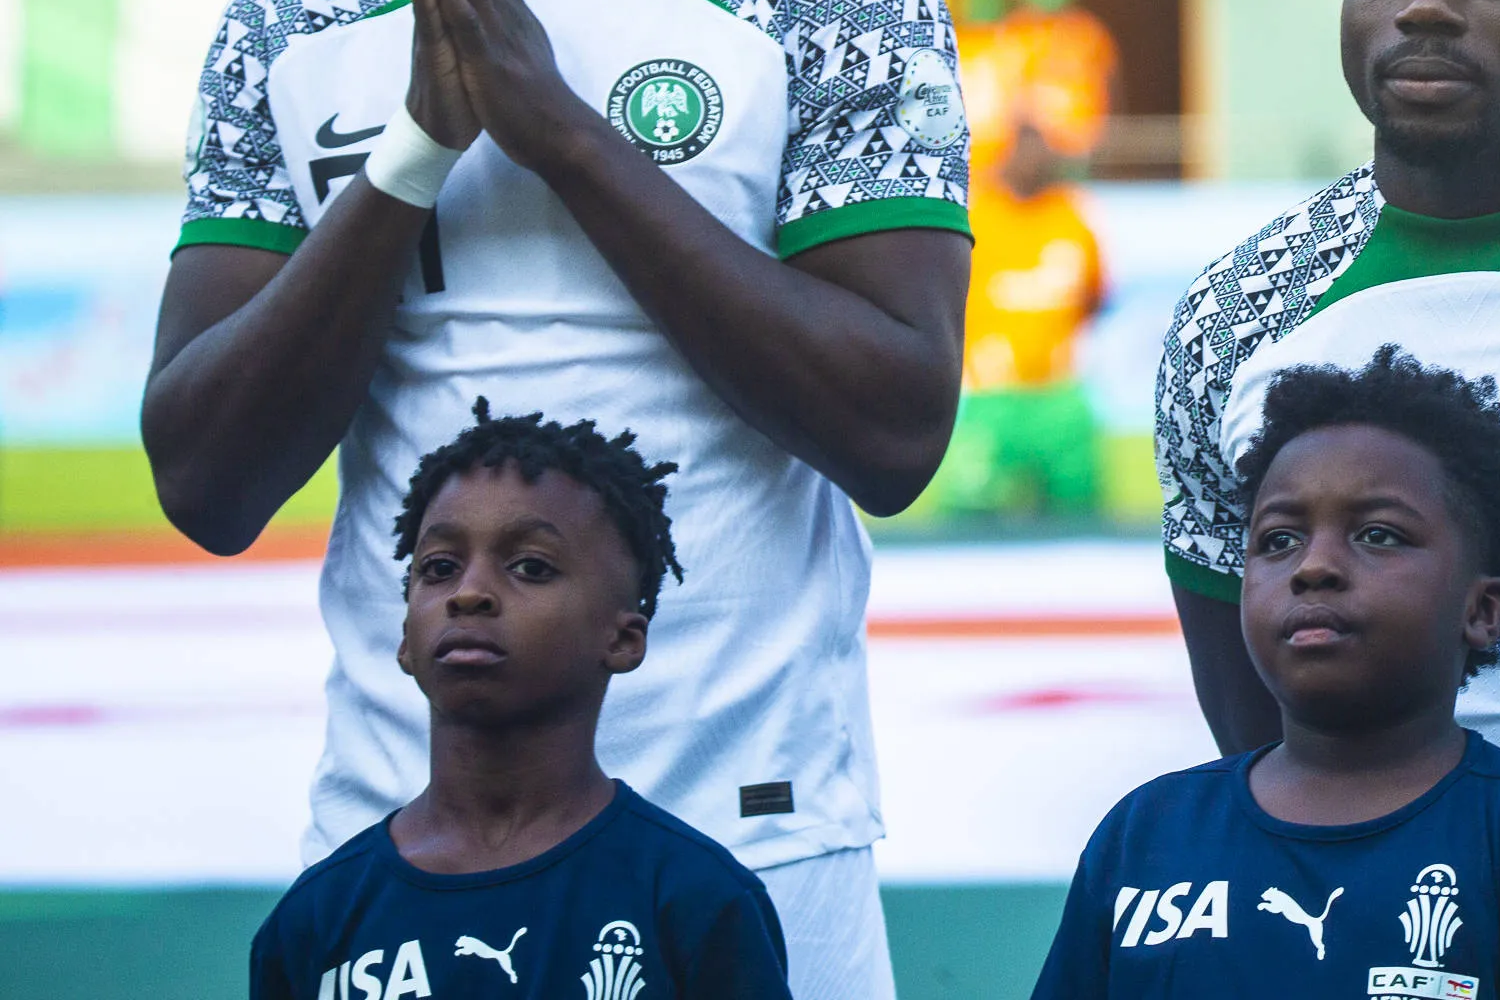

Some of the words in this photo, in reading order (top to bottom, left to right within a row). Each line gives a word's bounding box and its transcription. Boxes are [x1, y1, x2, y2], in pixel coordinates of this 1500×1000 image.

[616, 61, 686, 94] FOOTBALL
[686, 68, 721, 144] FEDERATION
[926, 107, 948, 118] CAF
[651, 147, 685, 161] 1945
[1373, 973, 1428, 989] CAF
